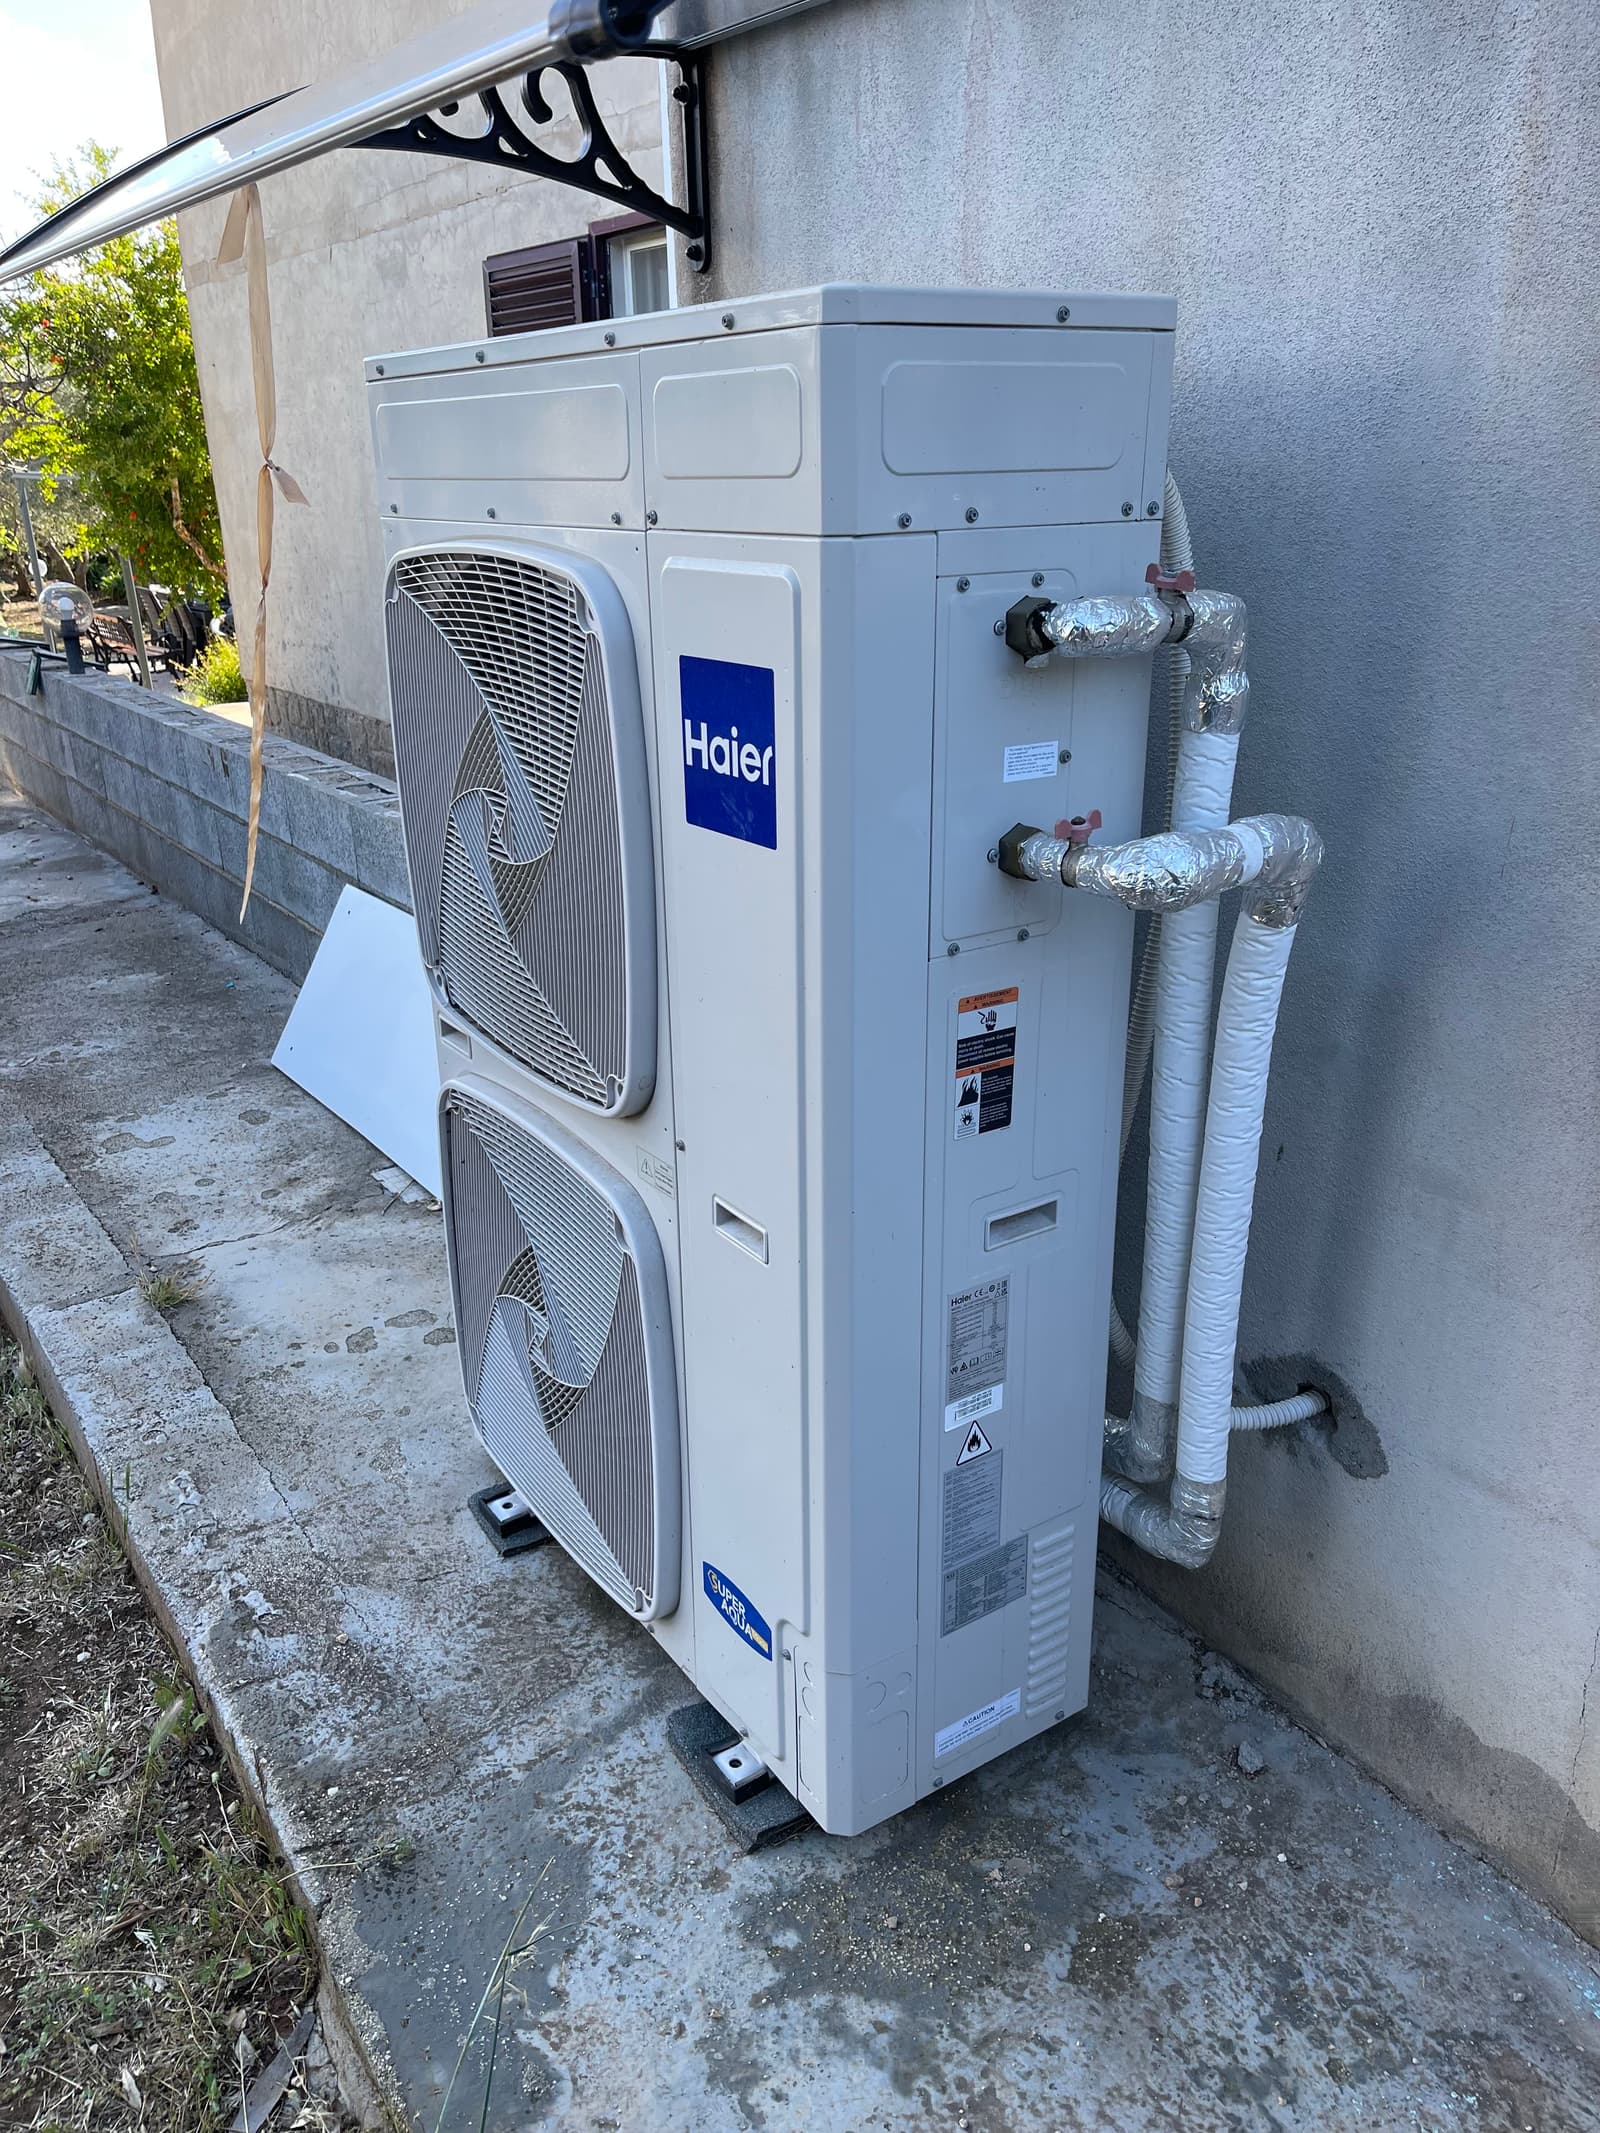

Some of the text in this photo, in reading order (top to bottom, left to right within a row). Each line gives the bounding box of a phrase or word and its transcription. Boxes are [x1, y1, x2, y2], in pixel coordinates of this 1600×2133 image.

[684, 718, 773, 786] Haier
[951, 1294, 972, 1307] Haier
[707, 1570, 746, 1616] SUPER
[721, 1598, 754, 1640] AQUA
[968, 1705, 995, 1724] CAUTION
